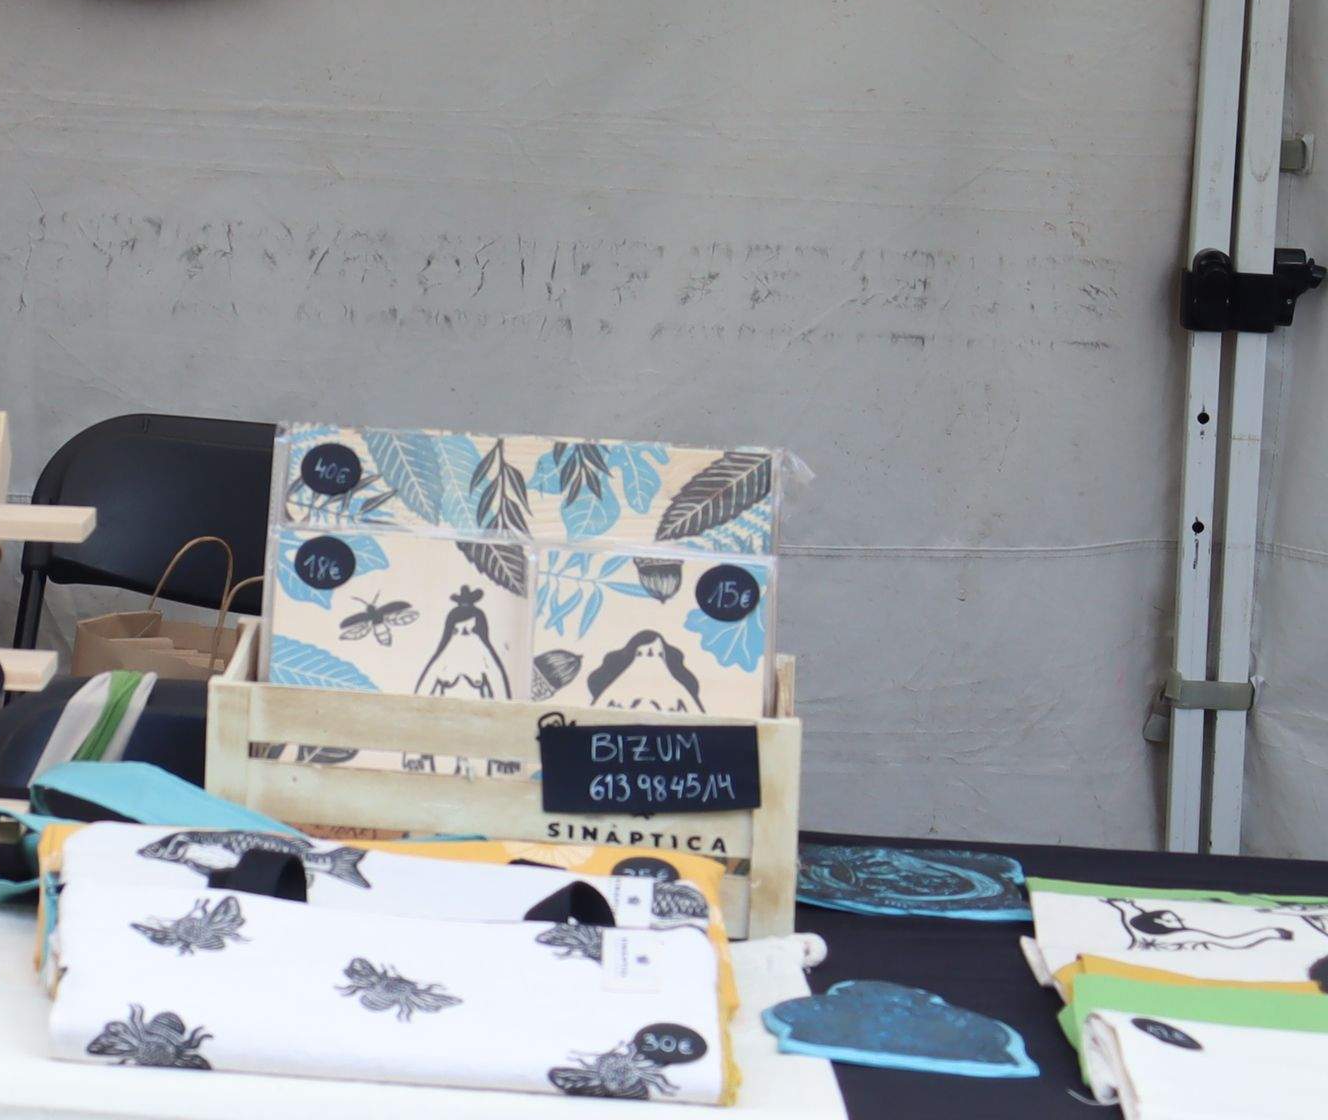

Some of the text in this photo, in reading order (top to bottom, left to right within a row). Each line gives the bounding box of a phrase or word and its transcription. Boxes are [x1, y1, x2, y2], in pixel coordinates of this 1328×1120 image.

[707, 580, 752, 608] 15€
[591, 732, 702, 764] BIZUM
[643, 1033, 694, 1055] 30€
